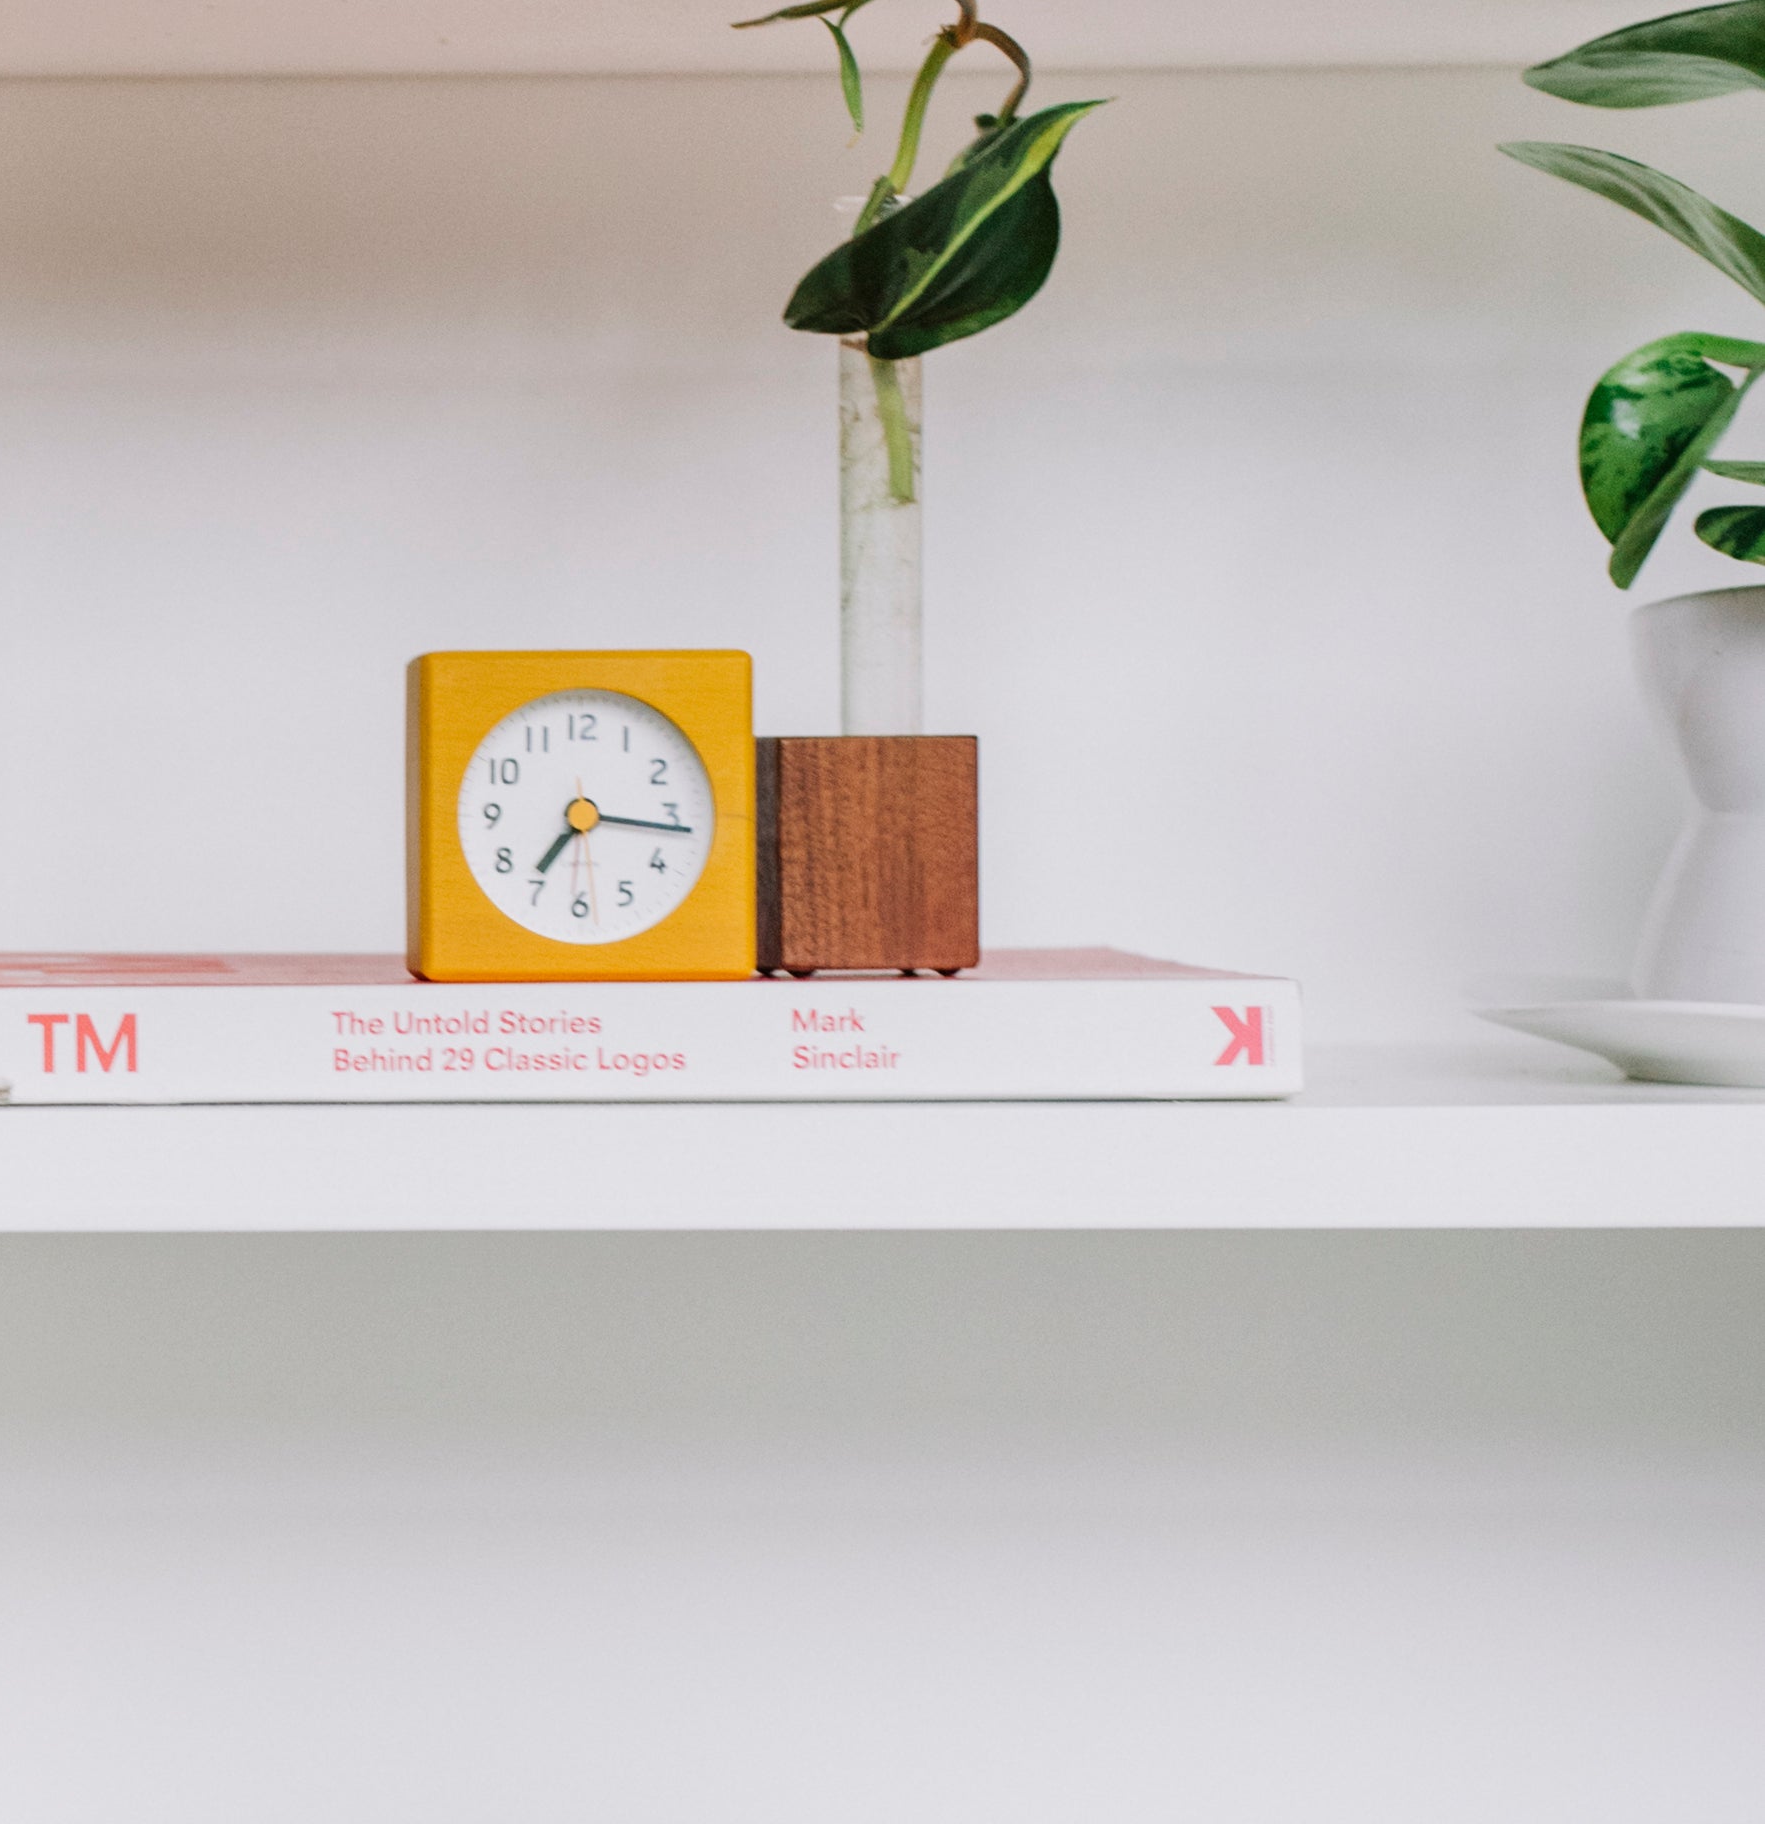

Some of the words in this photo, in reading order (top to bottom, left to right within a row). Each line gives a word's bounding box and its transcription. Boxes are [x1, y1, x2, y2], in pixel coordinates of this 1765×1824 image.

[526, 727, 548, 752] 11
[568, 714, 597, 741] 12
[489, 758, 519, 784] 10
[650, 759, 669, 785] 2
[483, 804, 501, 829] 9
[662, 804, 680, 827] 3
[496, 848, 513, 874] 8
[649, 849, 667, 873] 4
[528, 880, 545, 906] 7
[572, 892, 590, 917] 6
[617, 881, 634, 907] 5
[332, 1011, 384, 1036] The
[393, 1011, 489, 1036] Untold
[498, 1011, 602, 1036] Stories
[793, 1008, 866, 1034] Mark
[28, 1013, 138, 1073] TM
[334, 1048, 431, 1073] Behind
[442, 1049, 475, 1073] 29
[484, 1048, 589, 1073] Classic
[597, 1048, 687, 1076] Logos
[793, 1046, 900, 1071] Sinclair
